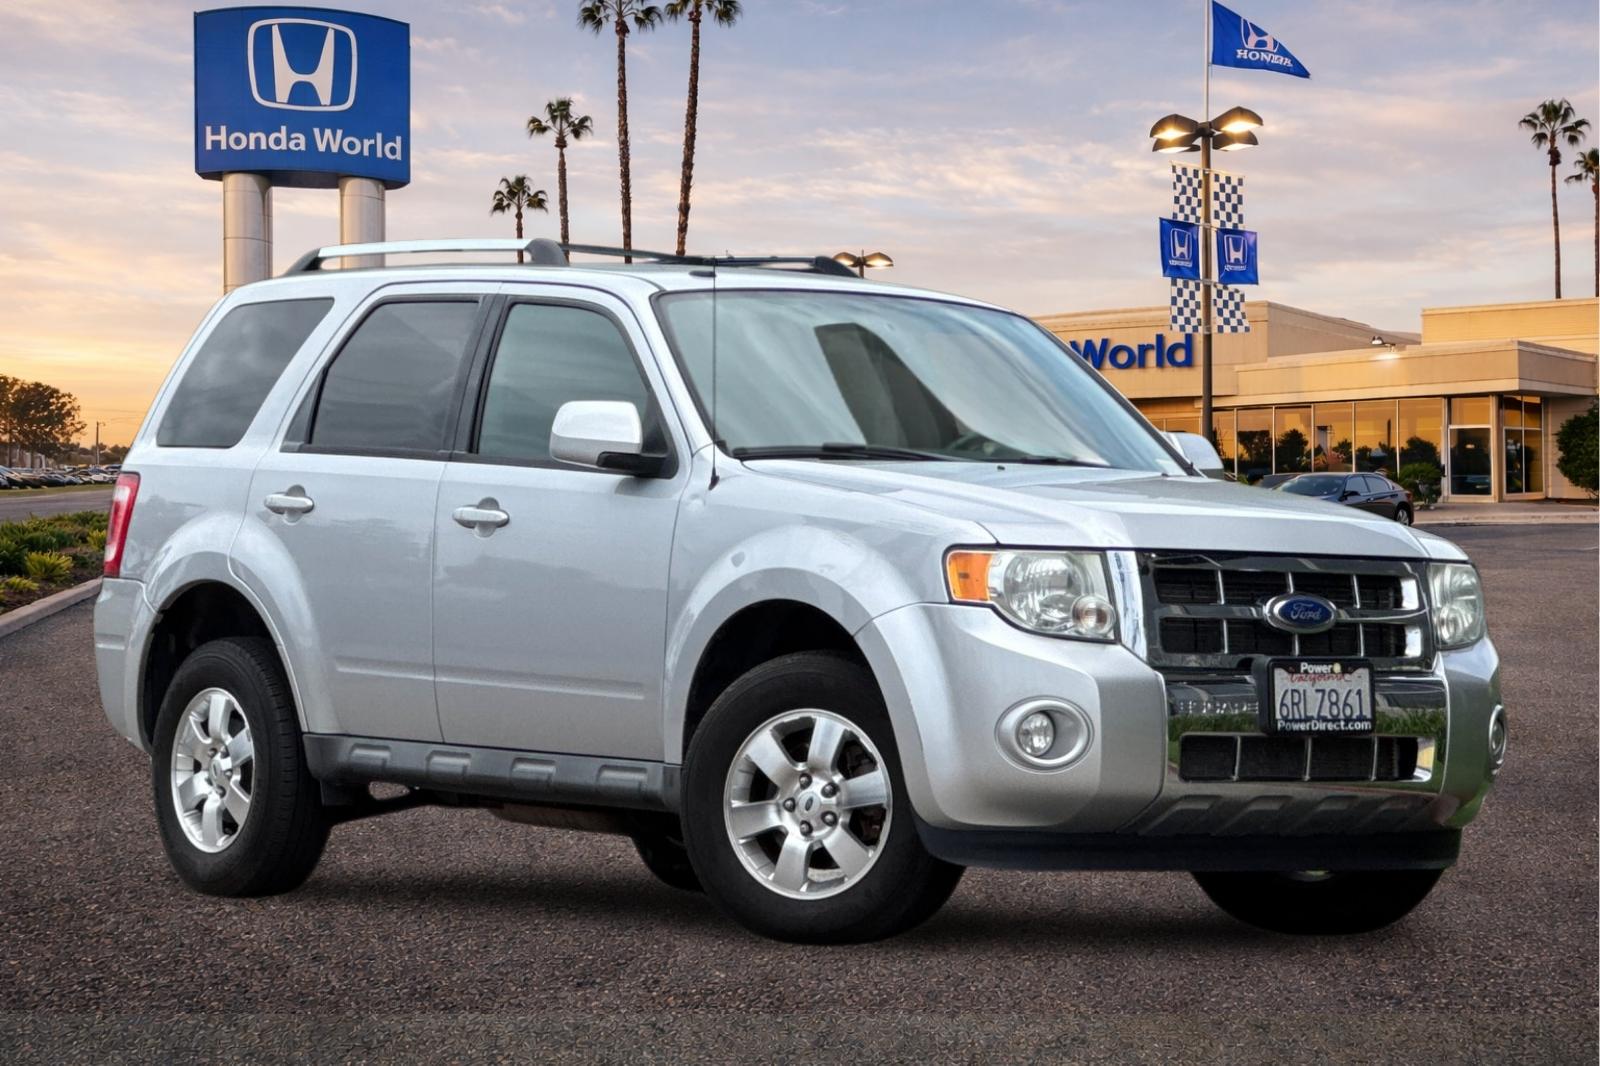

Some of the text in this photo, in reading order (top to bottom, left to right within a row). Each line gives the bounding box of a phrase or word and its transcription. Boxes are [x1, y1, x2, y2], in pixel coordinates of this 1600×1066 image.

[205, 125, 402, 161] Honda World
[1069, 333, 1195, 370] World
[1291, 602, 1322, 620] Ford
[1300, 662, 1333, 674] Power
[1277, 719, 1372, 732] PowerDirect.com
